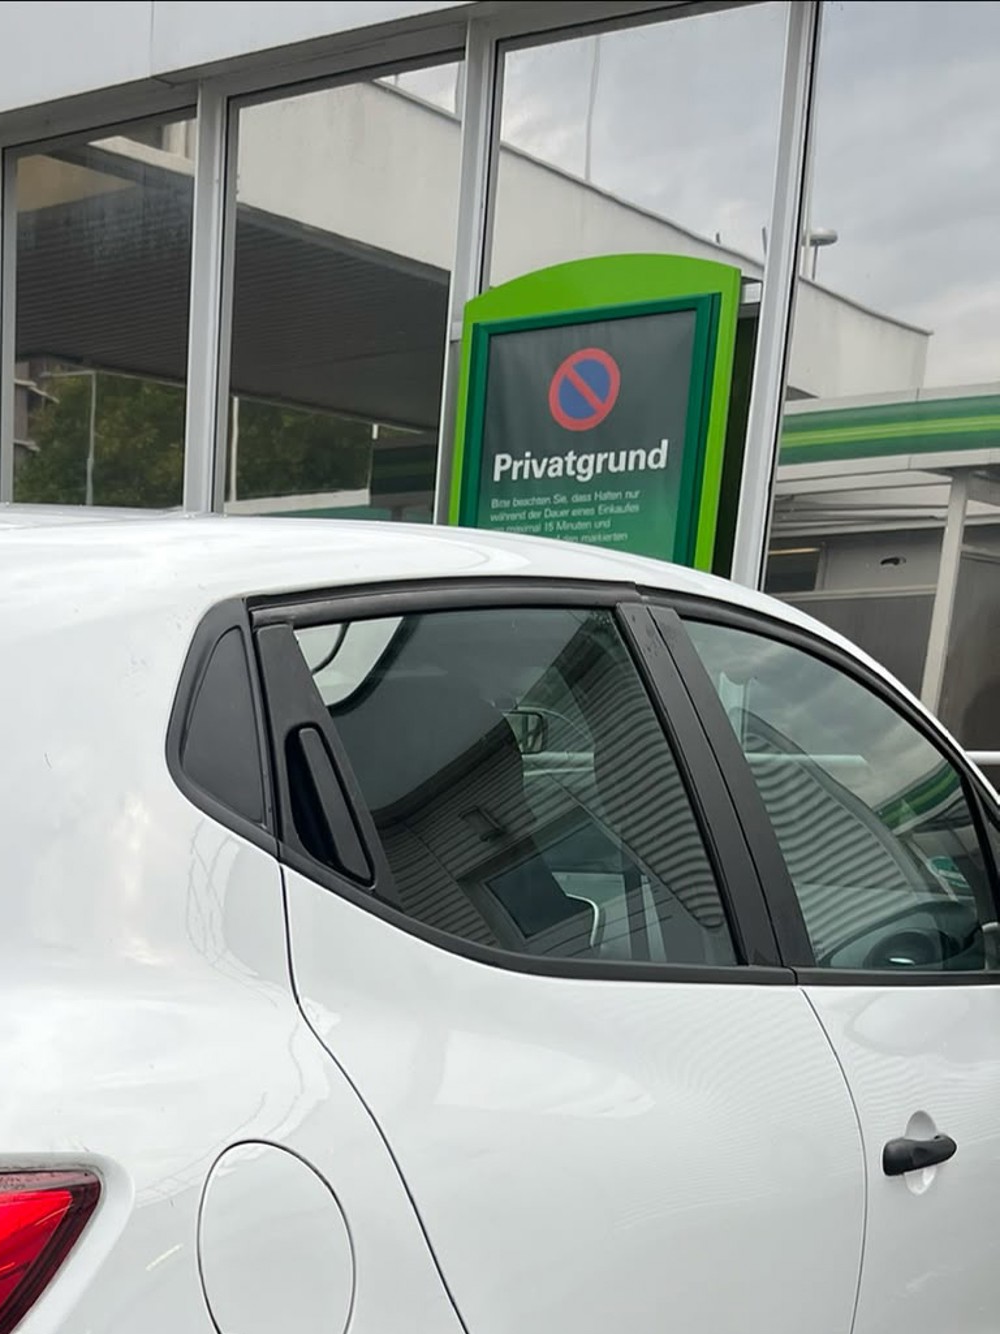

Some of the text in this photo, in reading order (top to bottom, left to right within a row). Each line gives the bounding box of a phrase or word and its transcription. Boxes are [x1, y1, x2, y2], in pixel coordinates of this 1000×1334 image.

[493, 439, 669, 482] Privatgrund
[571, 493, 592, 503] dass
[594, 490, 622, 501] Halten
[625, 489, 640, 499] nur
[528, 509, 542, 519] der
[544, 507, 570, 518] Dauer
[571, 507, 595, 516] eines
[544, 521, 554, 532] 15
[556, 520, 592, 531] Minuten
[594, 518, 612, 529] und
